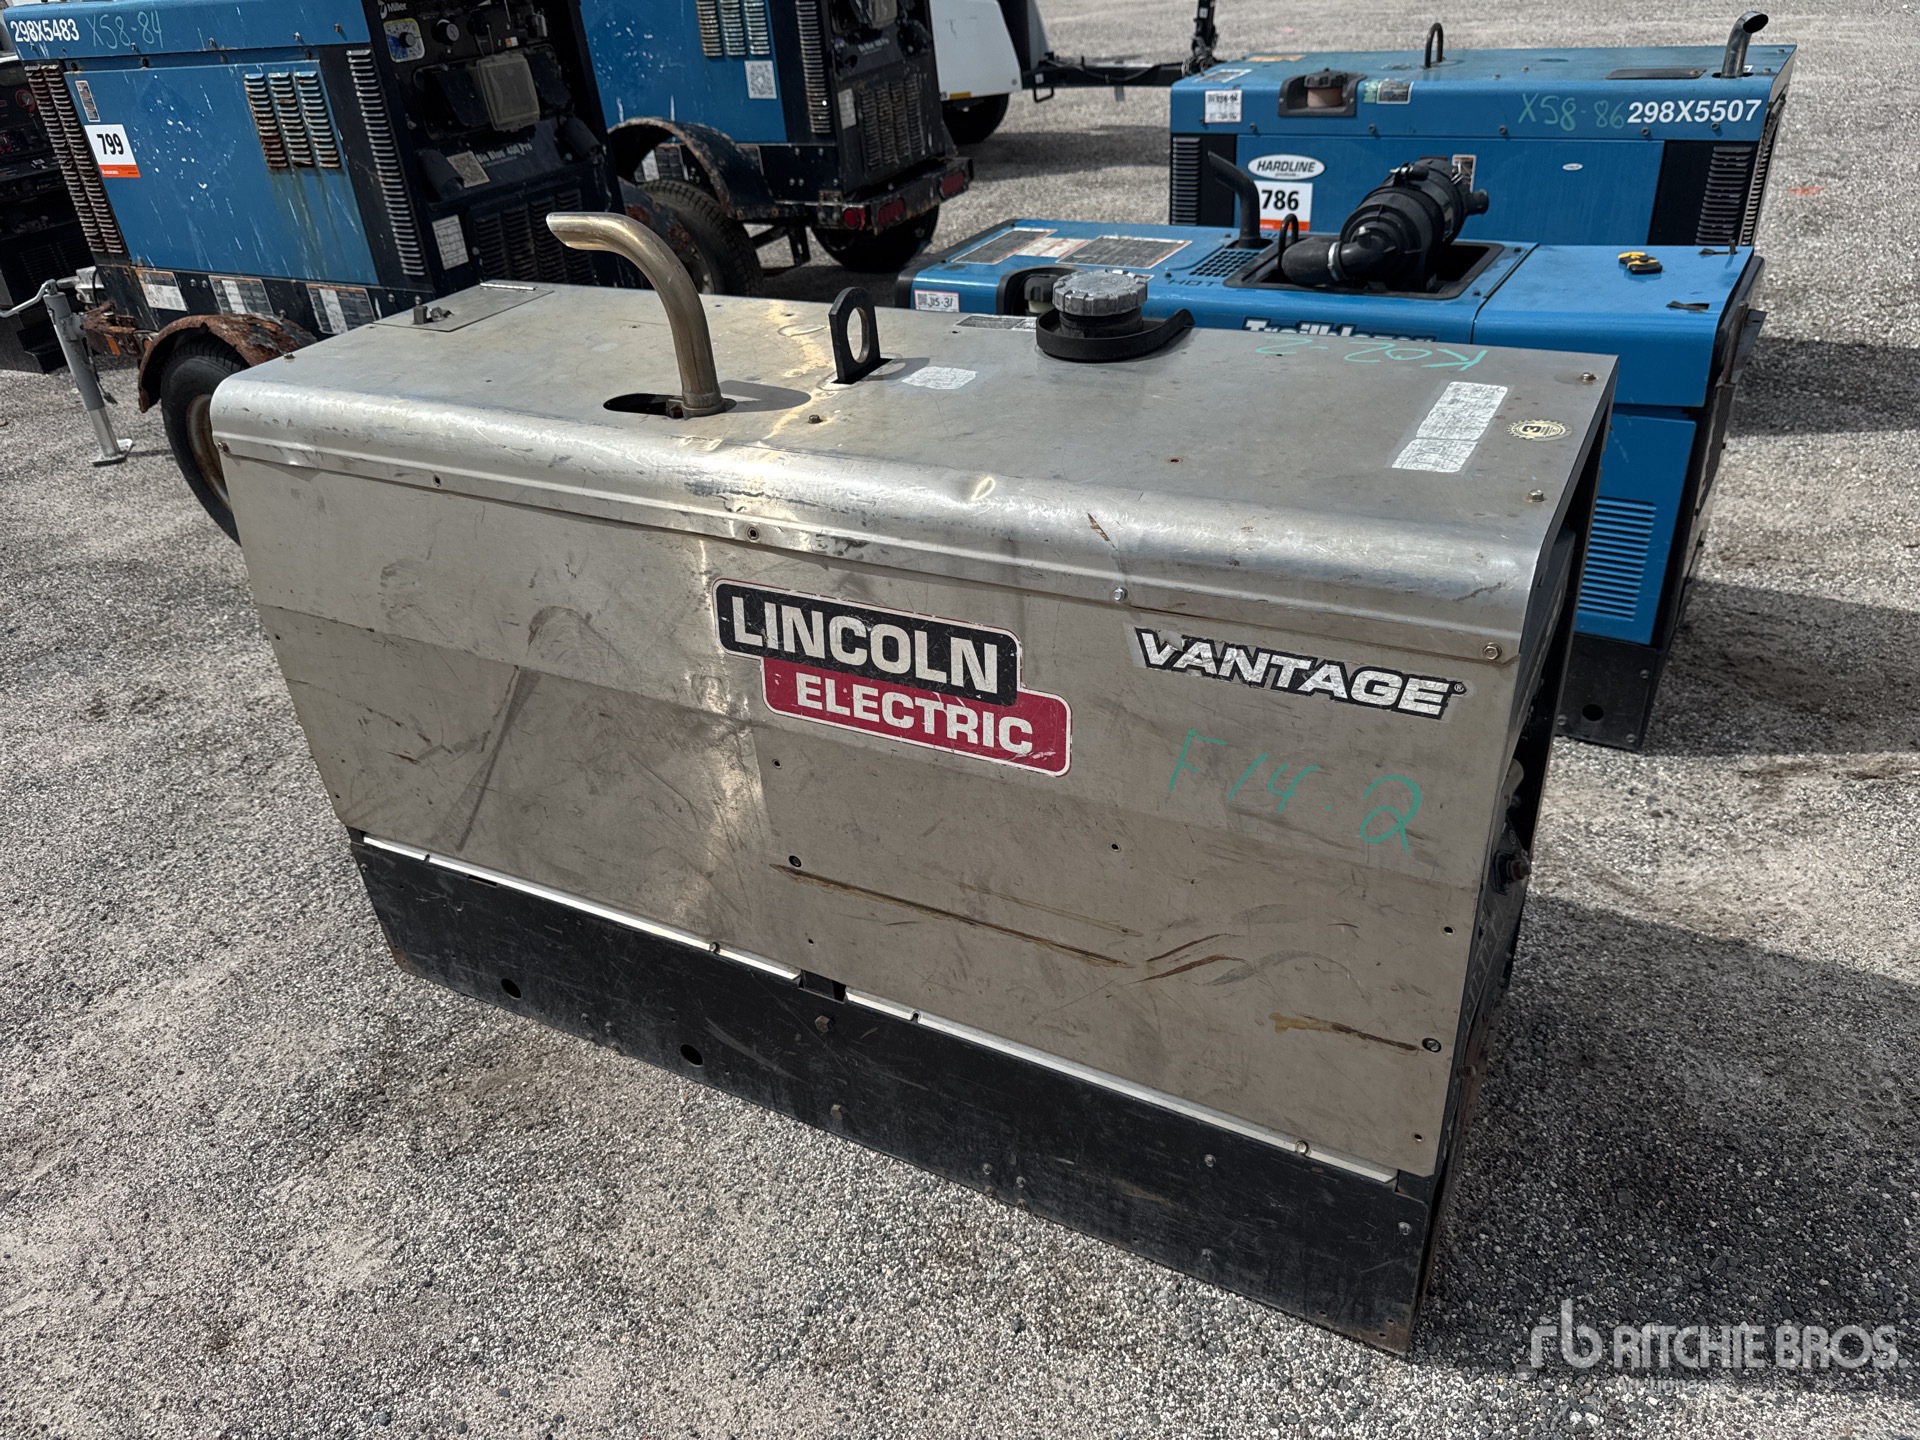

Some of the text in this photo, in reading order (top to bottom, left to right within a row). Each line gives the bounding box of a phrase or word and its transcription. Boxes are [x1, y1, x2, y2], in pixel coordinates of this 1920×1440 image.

[10, 18, 80, 43] 298X5483
[1627, 99, 1763, 123] 298X5507
[96, 132, 124, 155] 799
[1256, 159, 1317, 174] HARDLINE
[1261, 188, 1300, 211] 786
[1167, 278, 1222, 287] HOT
[731, 595, 998, 695] LINCOLN
[796, 672, 1034, 755] ELECTRIC
